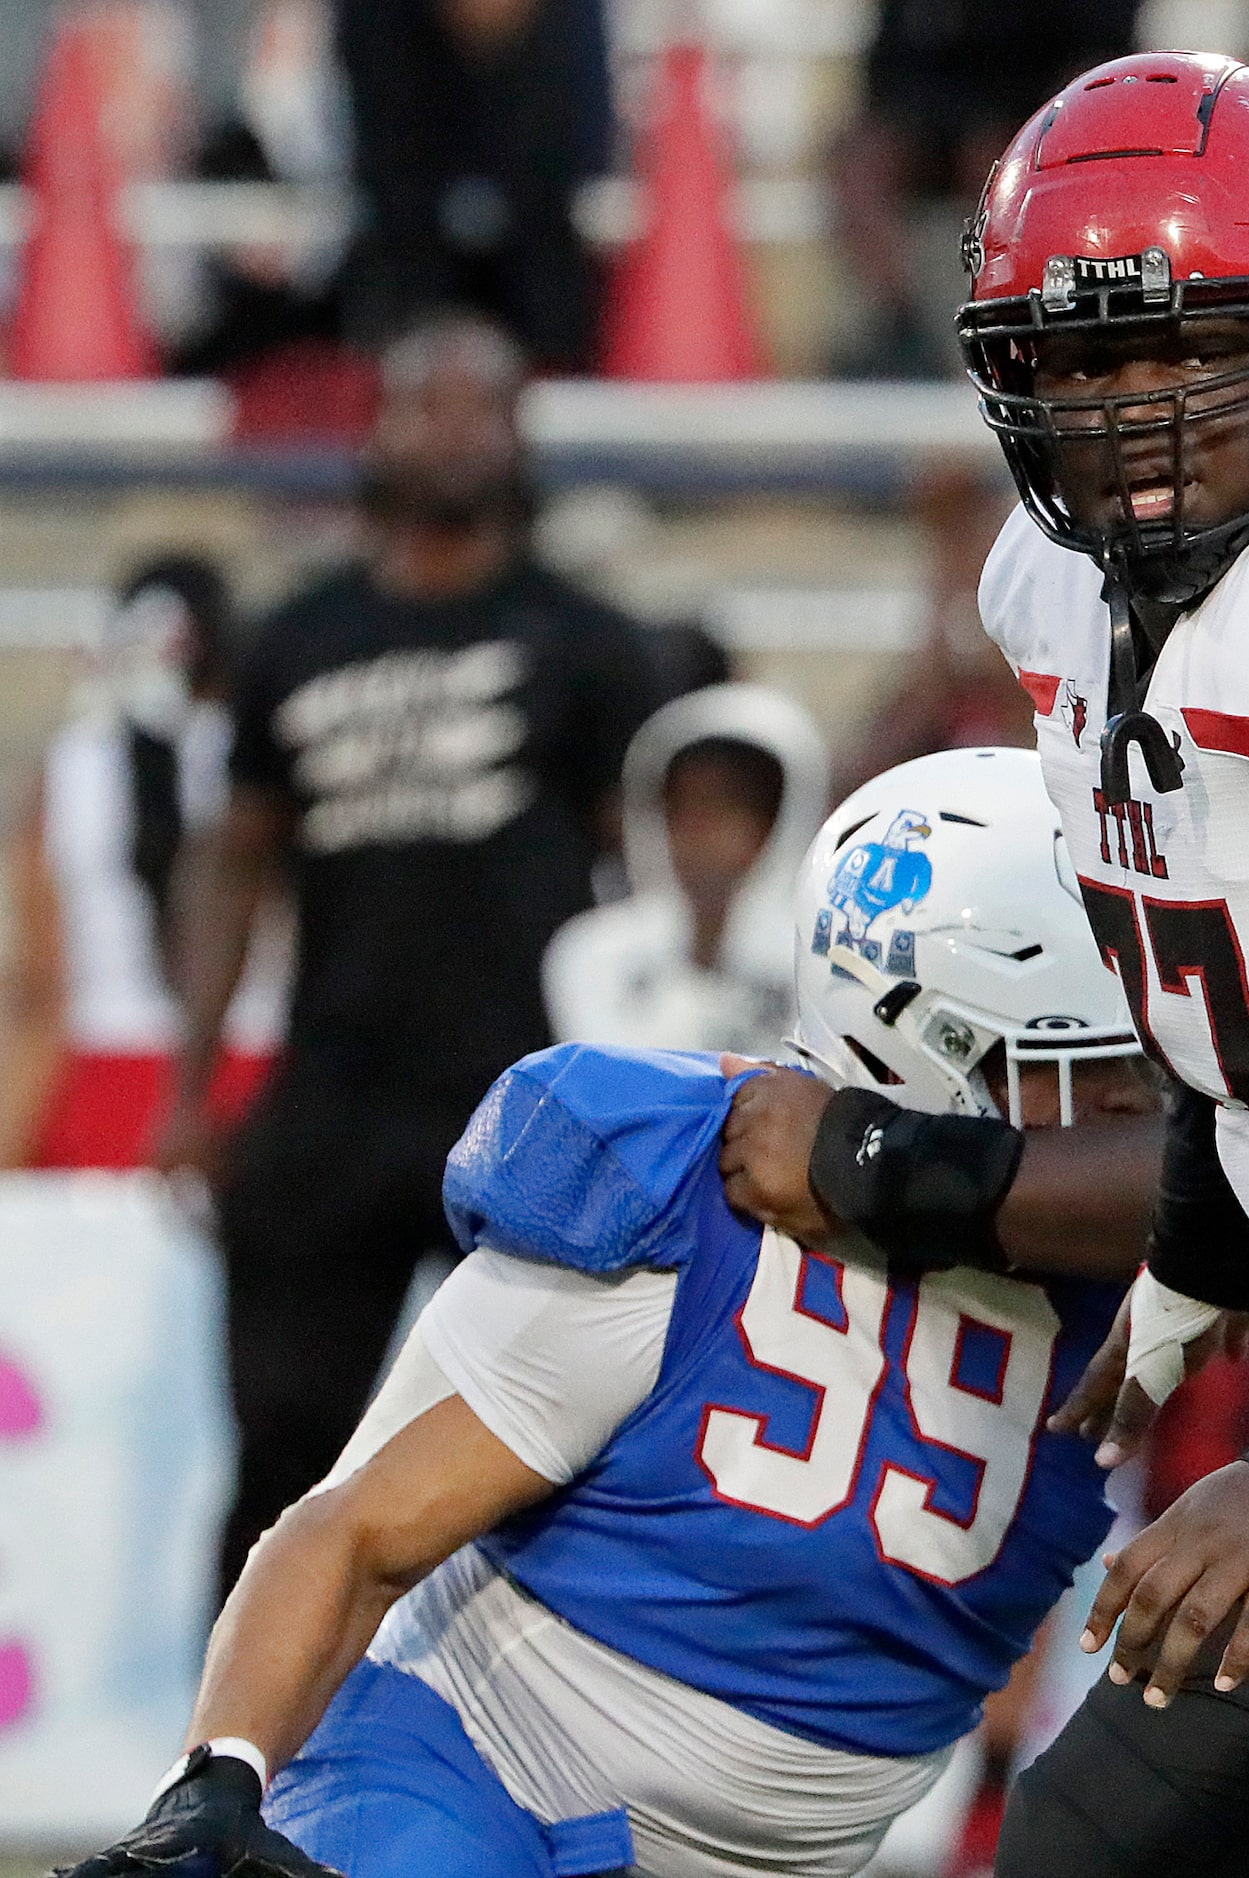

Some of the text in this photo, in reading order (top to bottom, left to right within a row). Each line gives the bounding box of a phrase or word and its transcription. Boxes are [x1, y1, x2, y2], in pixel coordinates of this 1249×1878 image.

[1077, 258, 1141, 279] TTHL
[1092, 786, 1170, 880] TTHL
[693, 1222, 1062, 1590] 99
